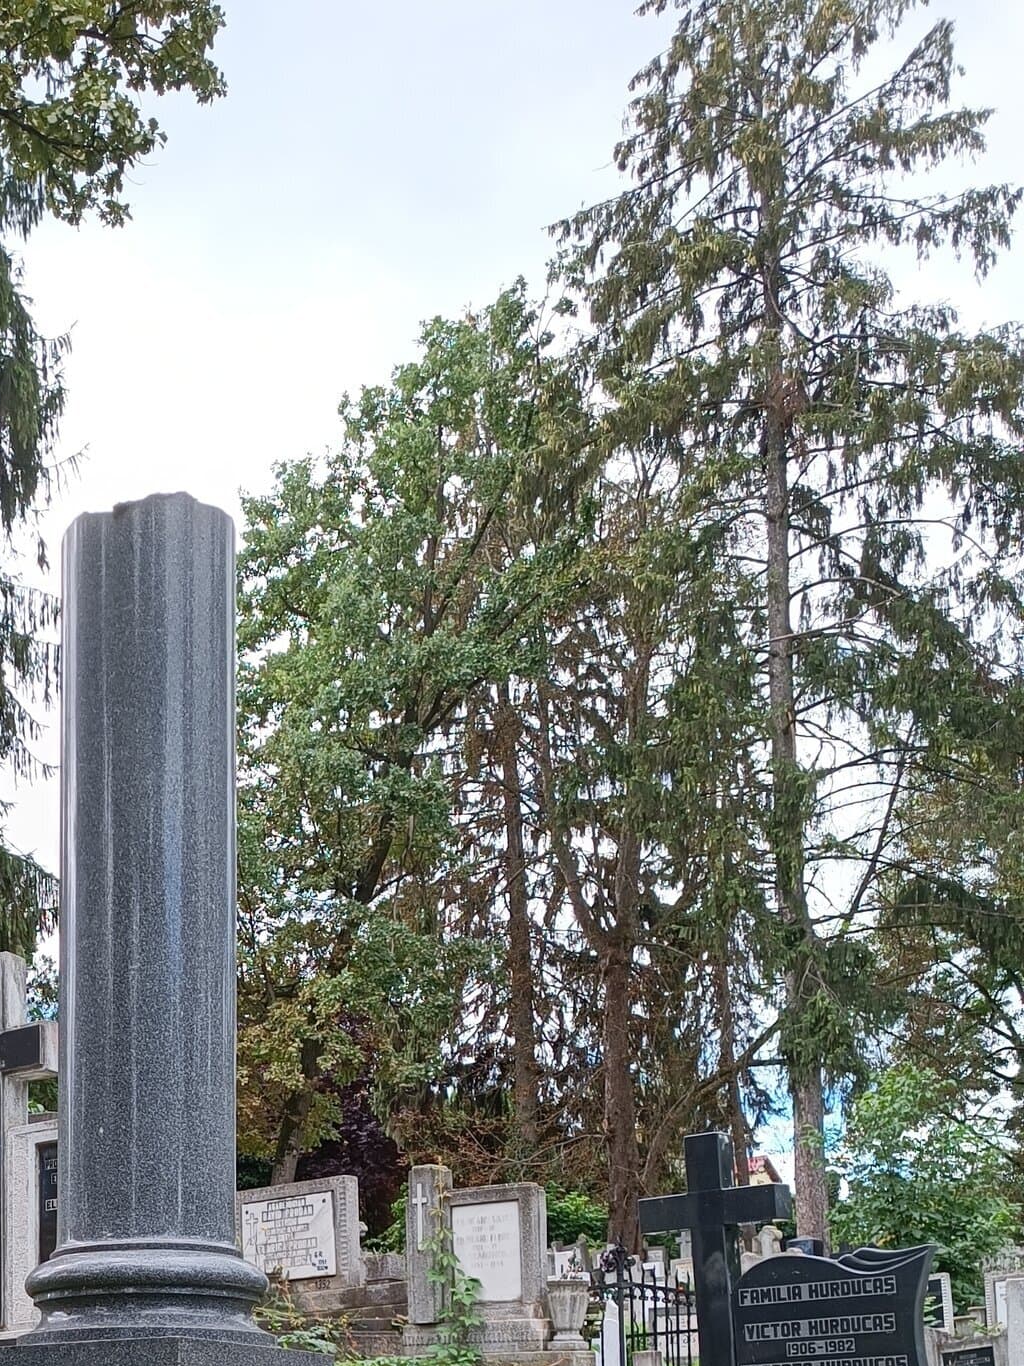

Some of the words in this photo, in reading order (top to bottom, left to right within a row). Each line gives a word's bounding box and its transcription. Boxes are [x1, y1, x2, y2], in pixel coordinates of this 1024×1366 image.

[740, 1285, 802, 1305] FAMILIA
[746, 1323, 801, 1340] VICTOR
[787, 1340, 854, 1355] 1906-1982
